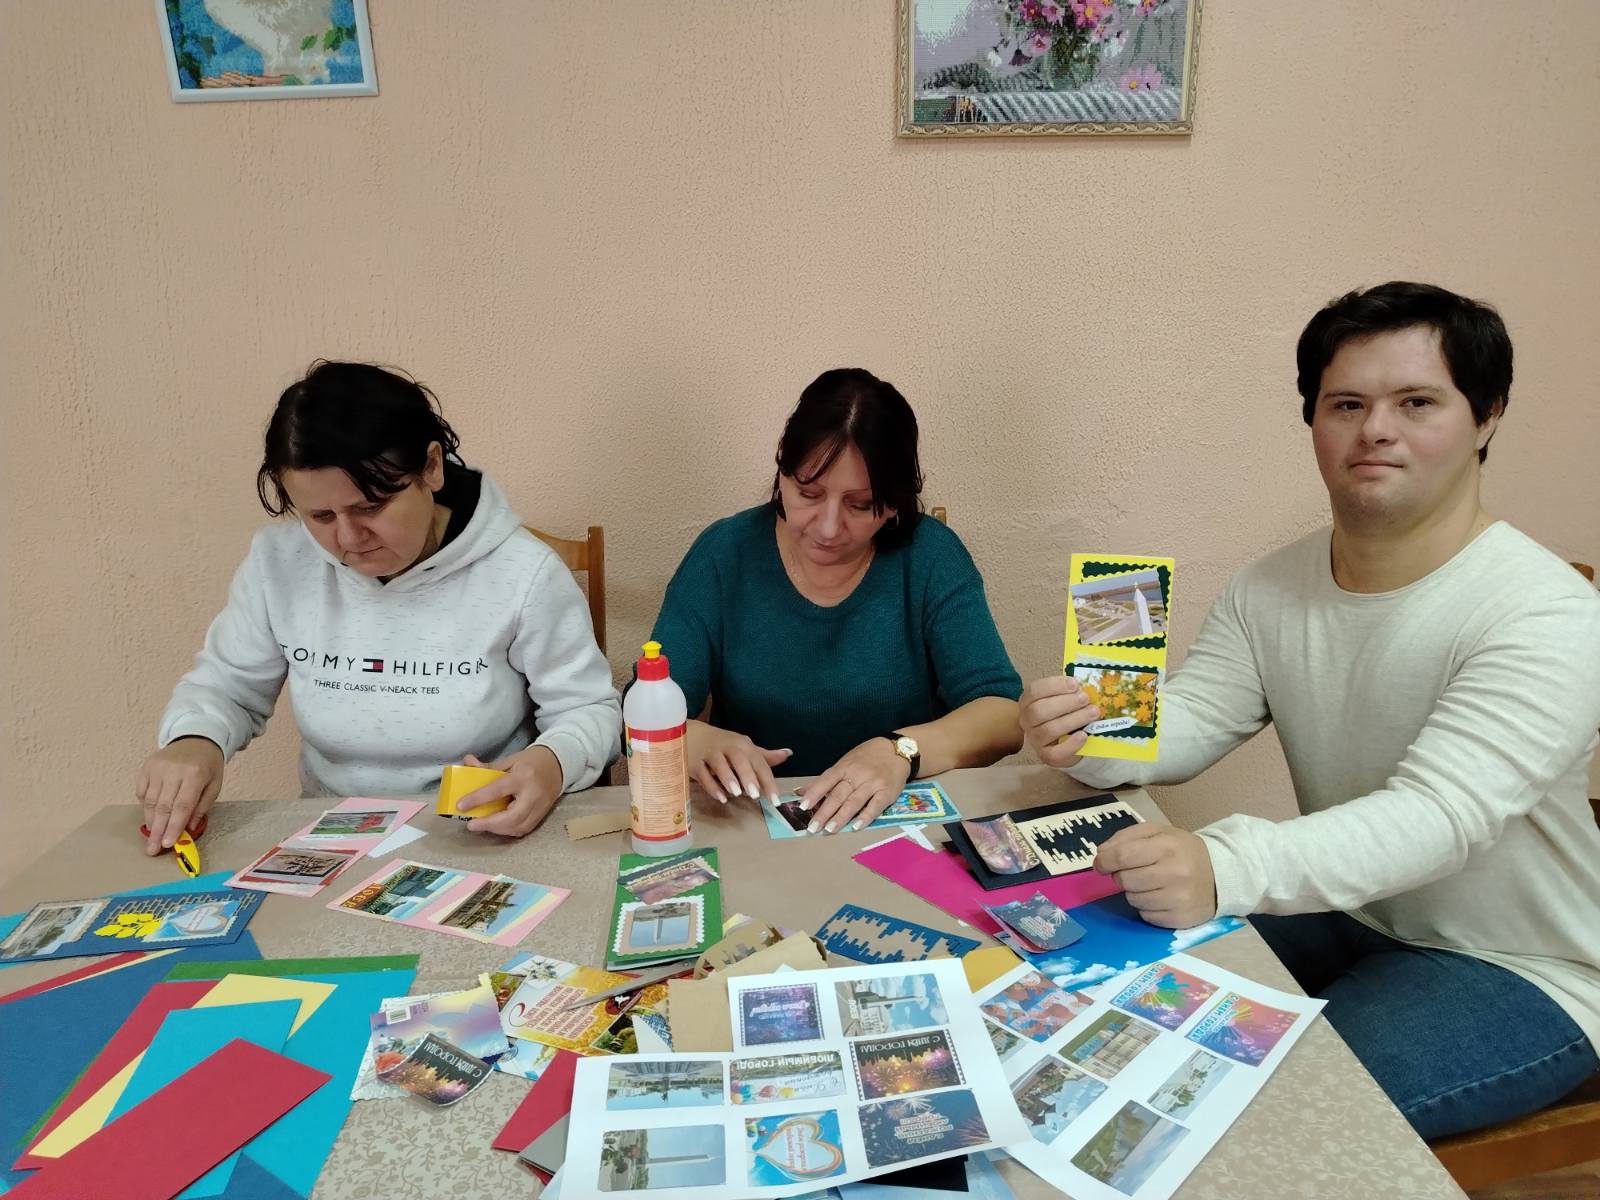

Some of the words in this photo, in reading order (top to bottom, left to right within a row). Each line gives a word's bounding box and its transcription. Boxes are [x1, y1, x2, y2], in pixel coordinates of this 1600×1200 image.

[314, 679, 341, 690] THREE
[344, 682, 377, 692] CLASSIC
[380, 685, 418, 694] V-NEACK
[421, 686, 440, 695] TEES
[932, 1035, 941, 1043] С
[736, 1059, 775, 1070] ГОРОД!
[777, 1053, 835, 1066] ЛЮБИМЫЙ
[472, 1067, 482, 1078] С
